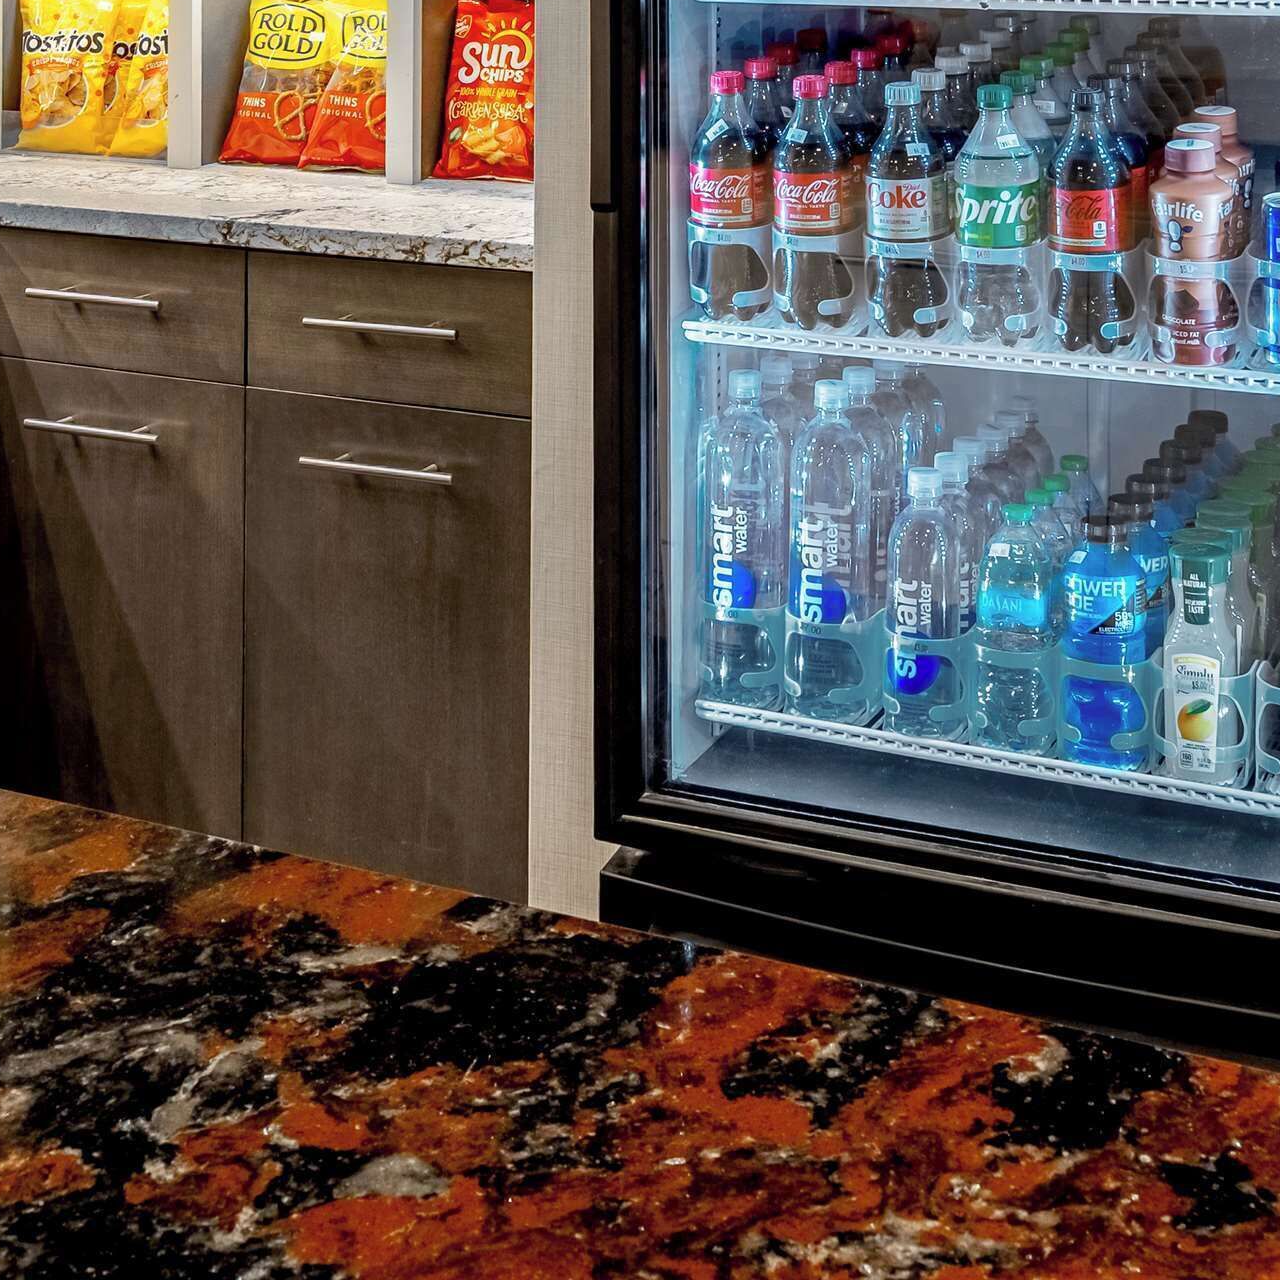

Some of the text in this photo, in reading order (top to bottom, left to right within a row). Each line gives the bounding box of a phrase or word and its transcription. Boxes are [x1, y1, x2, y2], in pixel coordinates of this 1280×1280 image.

[259, 13, 317, 34] ROLD
[253, 33, 313, 54] GOLD
[458, 40, 521, 84] Sun
[479, 70, 525, 84] CHIPS
[242, 97, 266, 108] THINS
[328, 95, 358, 107] THINS
[690, 174, 751, 199] Coca-Cola
[773, 177, 840, 204] Coca-Cola
[869, 182, 926, 209] Coke
[956, 190, 1036, 227] Sprite
[733, 506, 749, 554] water
[826, 522, 839, 568] water
[1183, 579, 1206, 588] NATURAL
[918, 579, 932, 627] water
[1188, 606, 1204, 614] TASTE
